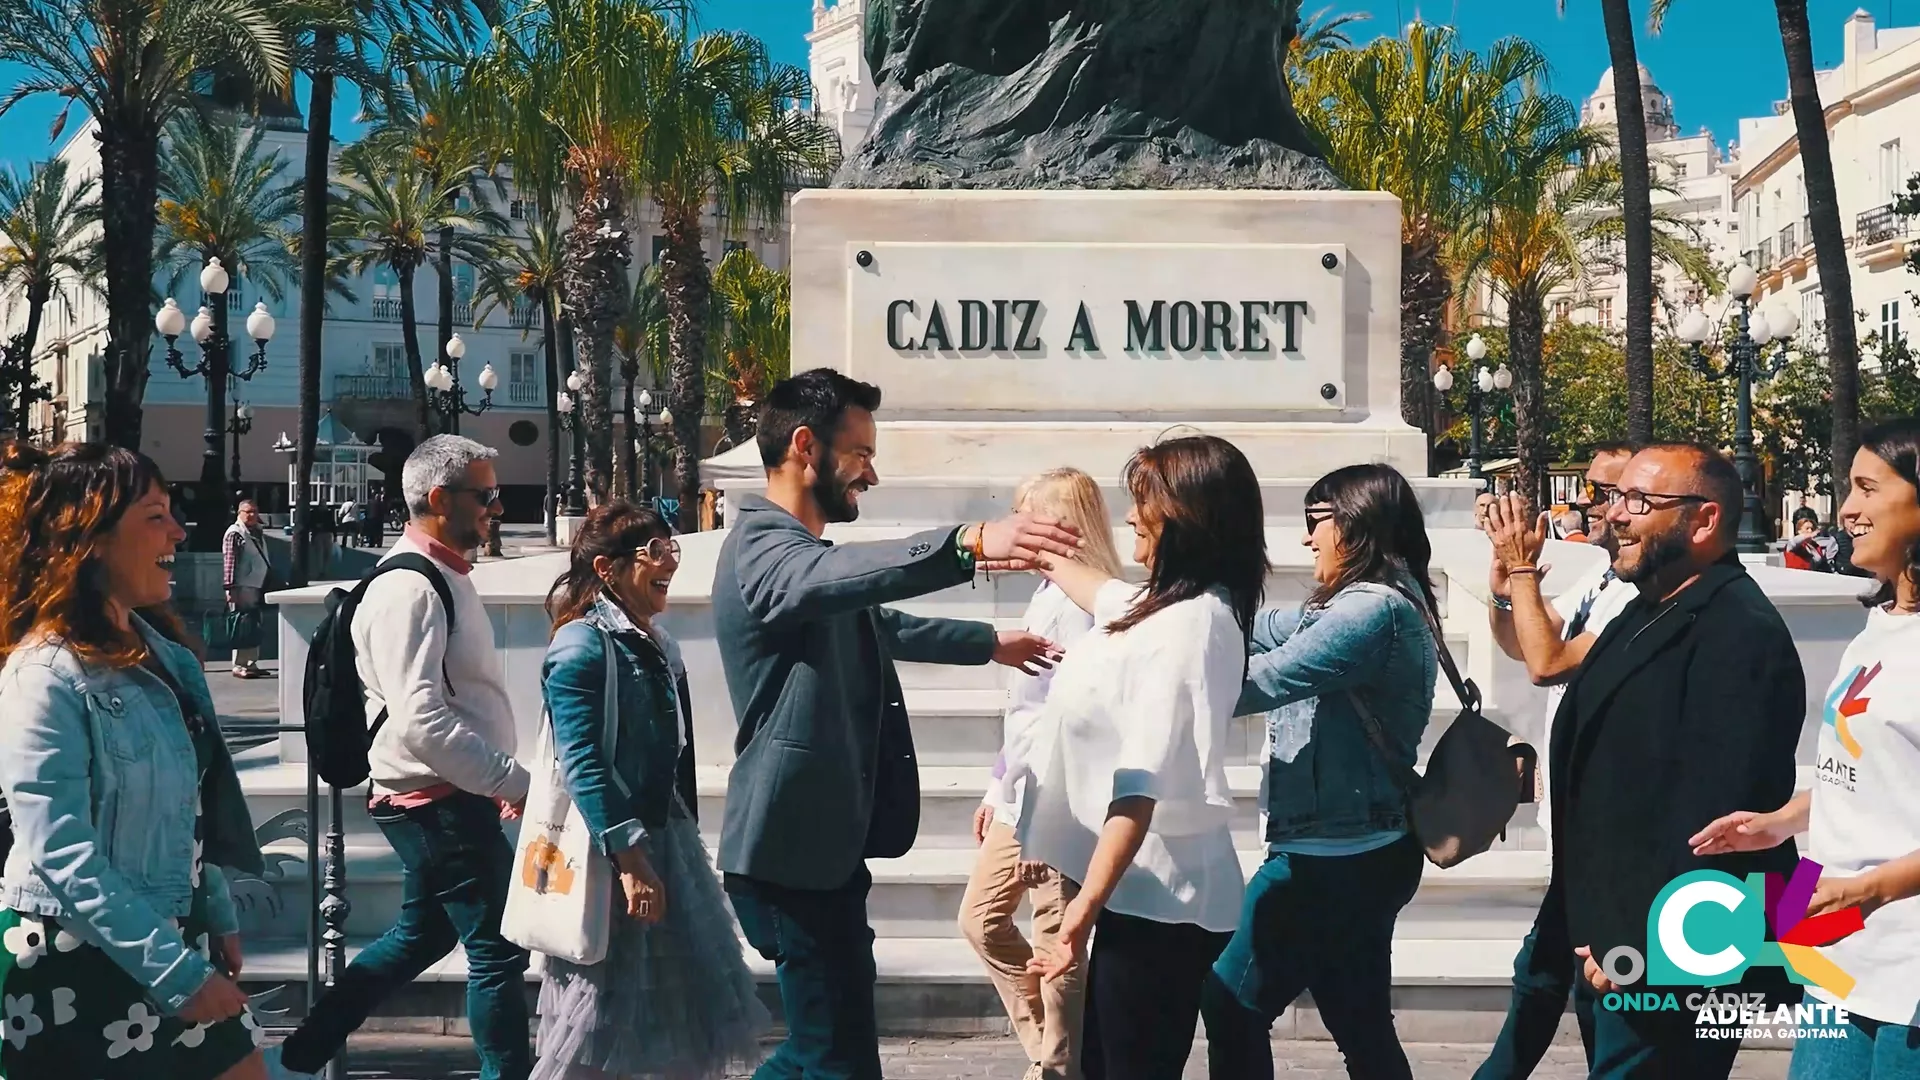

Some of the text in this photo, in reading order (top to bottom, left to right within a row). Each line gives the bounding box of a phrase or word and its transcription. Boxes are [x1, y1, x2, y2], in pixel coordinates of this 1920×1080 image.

[886, 299, 1308, 352] CADIZ A MORET
